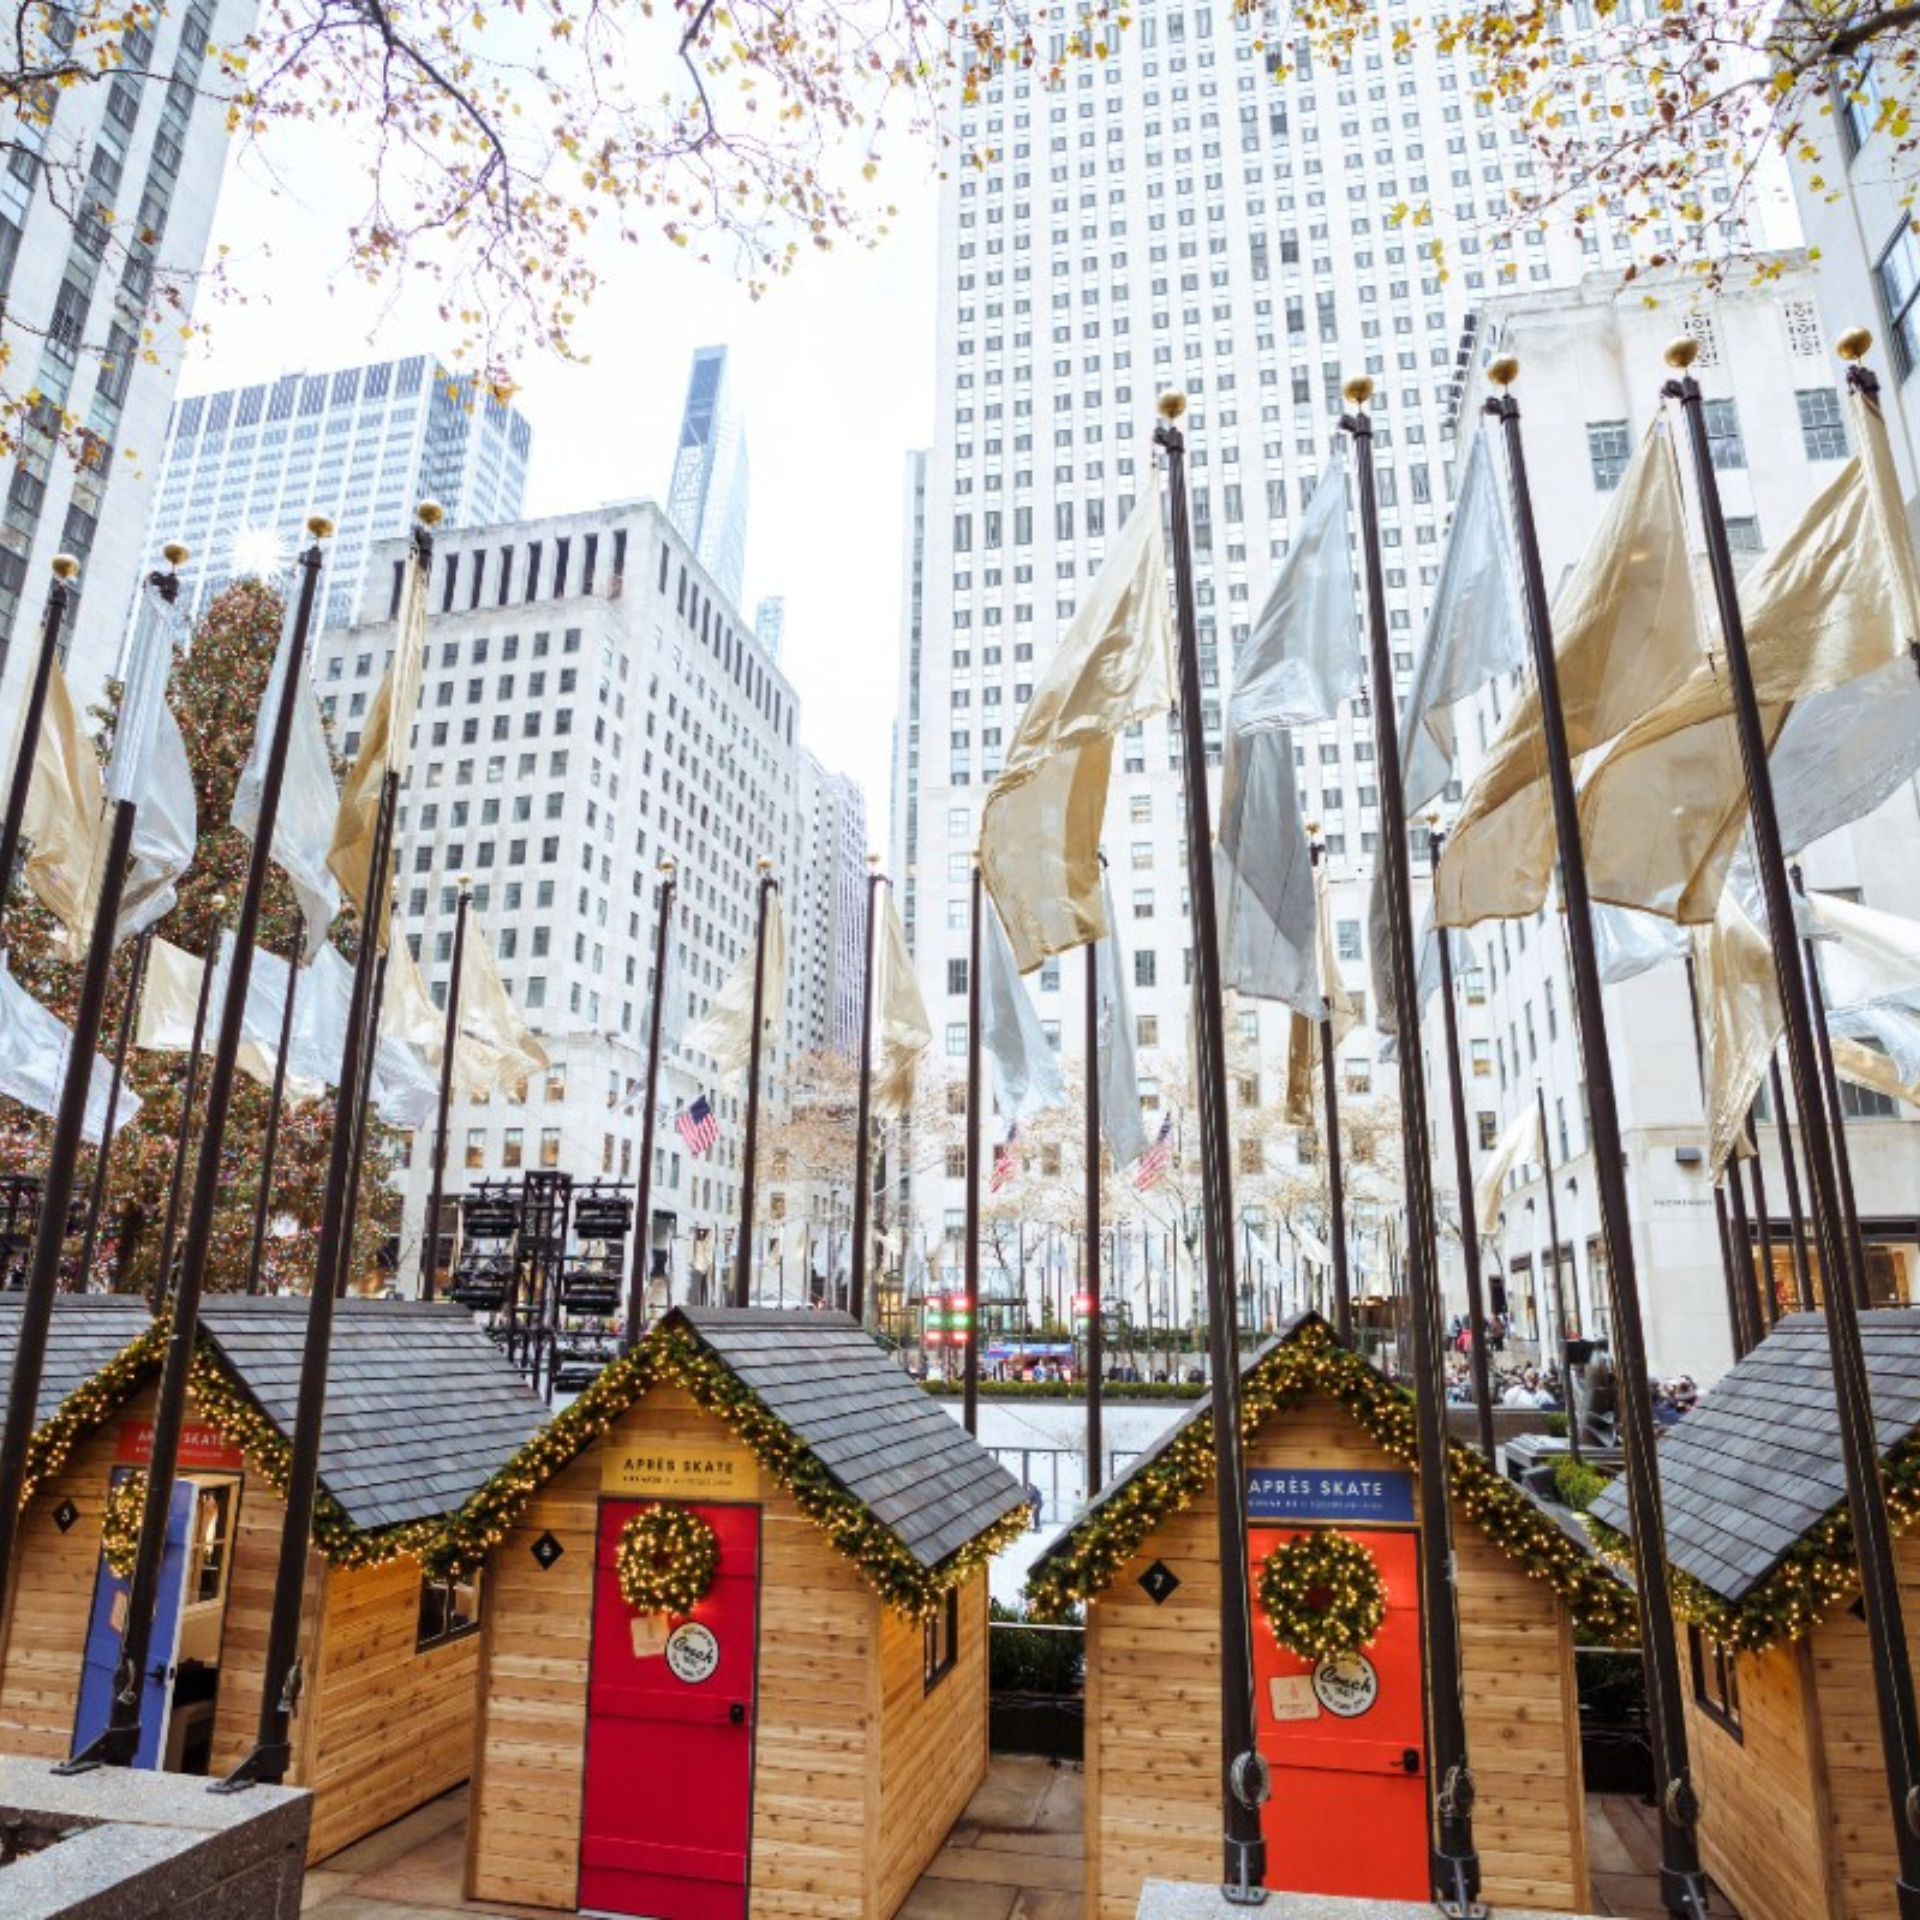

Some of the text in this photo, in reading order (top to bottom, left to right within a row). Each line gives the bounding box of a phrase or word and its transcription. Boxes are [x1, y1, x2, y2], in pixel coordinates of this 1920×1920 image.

[623, 1456, 733, 1475] APRÈS SKATE
[1248, 1475, 1383, 1497] APRÈS SKATE
